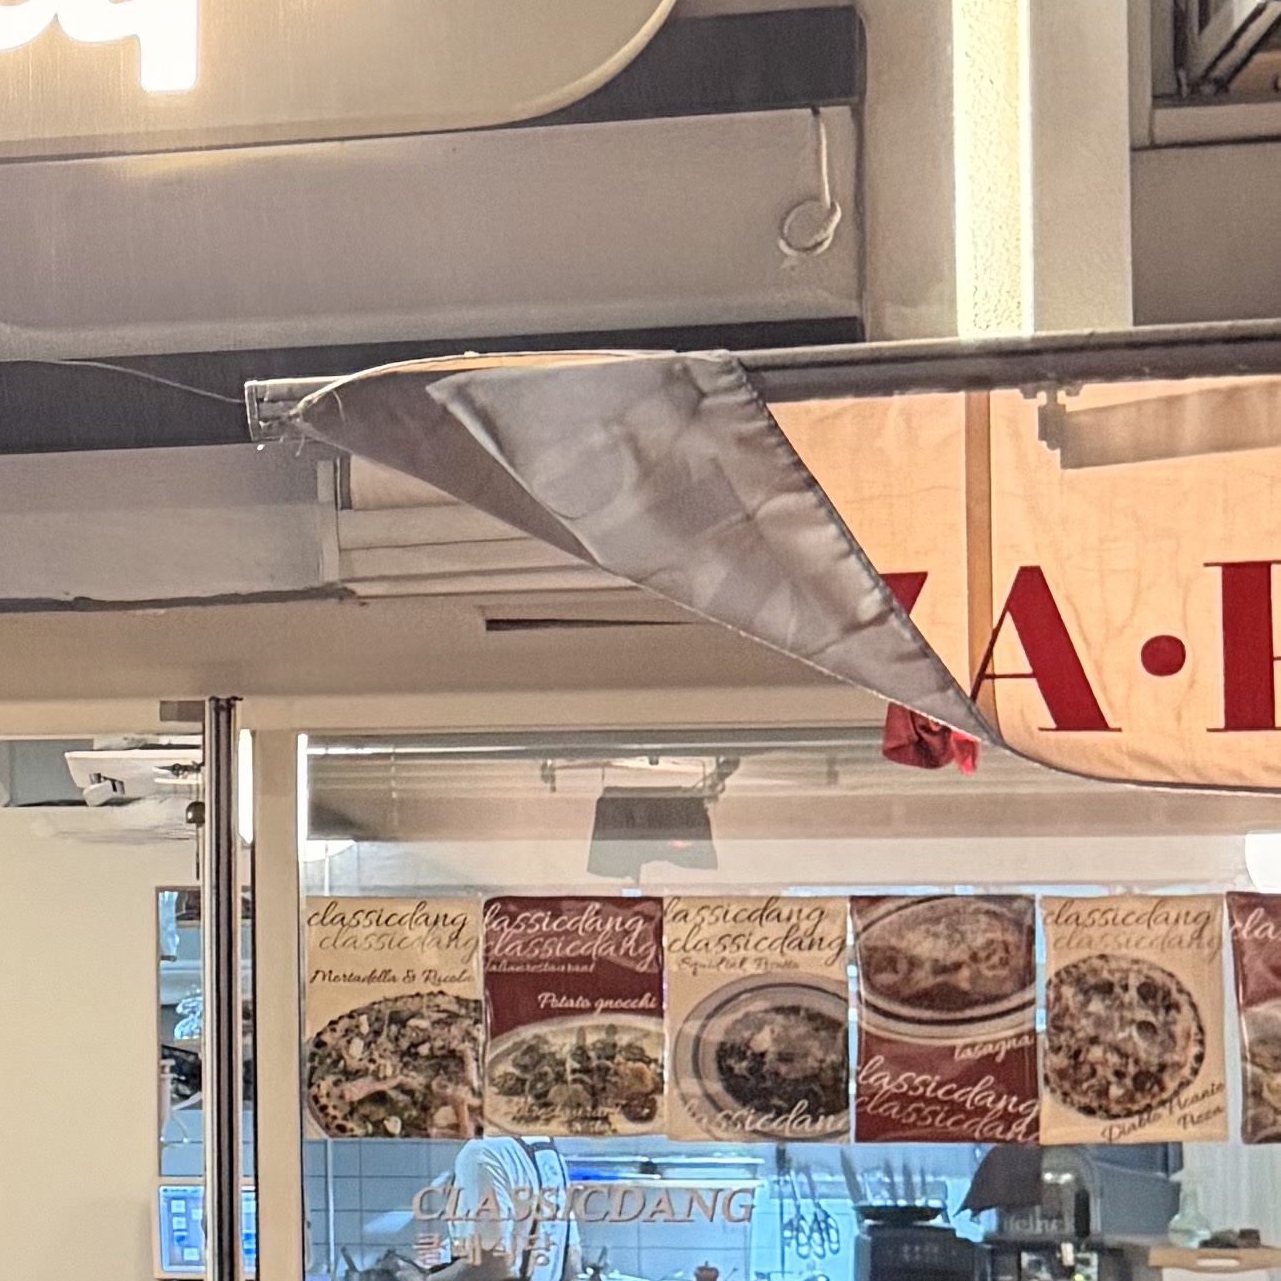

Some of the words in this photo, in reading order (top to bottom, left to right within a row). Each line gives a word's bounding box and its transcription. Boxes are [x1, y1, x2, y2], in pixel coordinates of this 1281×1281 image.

[307, 901, 469, 940] classicdang
[668, 922, 846, 967] classicdang
[538, 992, 591, 1010] Potato
[412, 1185, 756, 1223] CLASSICDANG
